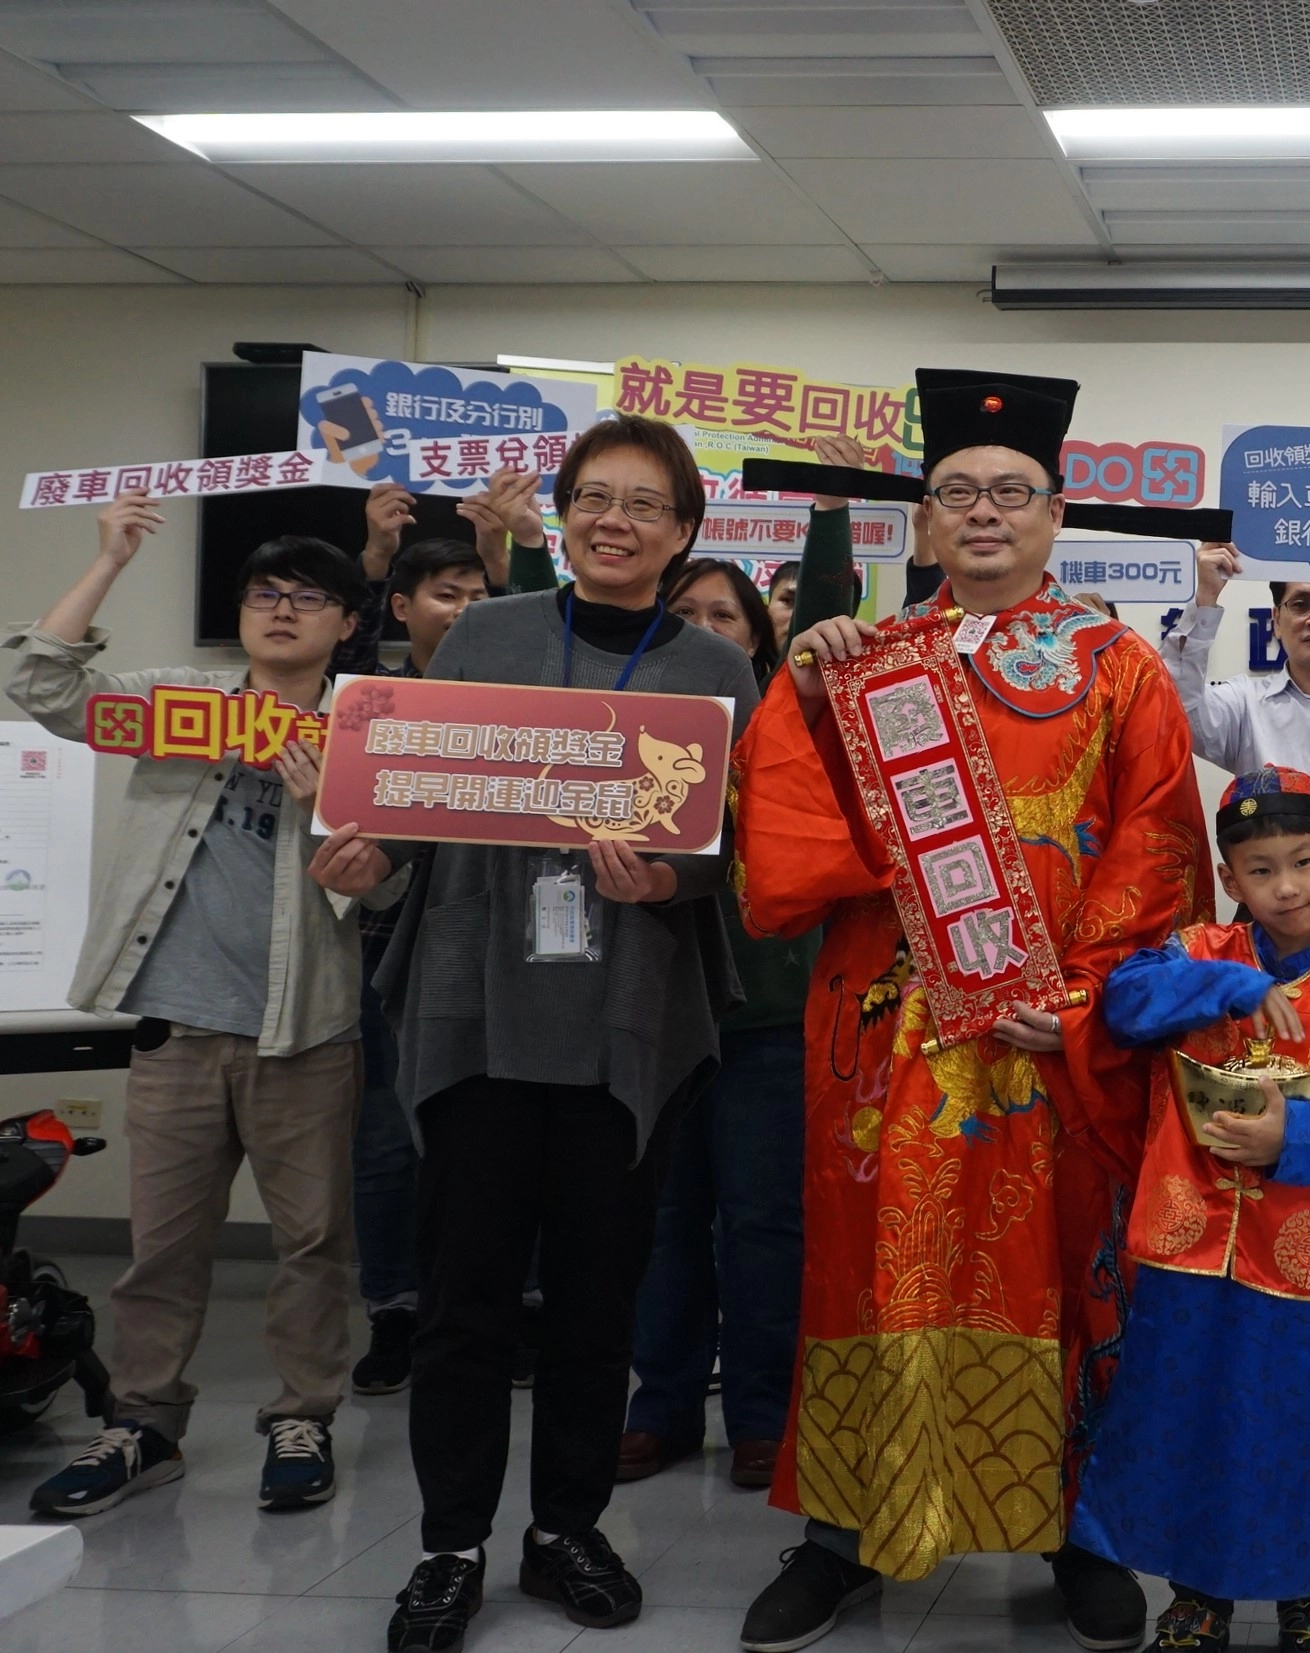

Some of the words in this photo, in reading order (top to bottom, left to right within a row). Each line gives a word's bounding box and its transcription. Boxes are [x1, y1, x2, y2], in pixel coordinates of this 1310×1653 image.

[385, 391, 543, 431] 銀行及分行別
[615, 362, 905, 443] 就是要回收
[30, 451, 314, 506] 廢車回收領獎金
[1065, 453, 1133, 492] DO
[1060, 560, 1182, 584] 機車300元
[365, 719, 625, 767] 廢車回收領獎金
[373, 769, 636, 819] 提早開運迎金鼠
